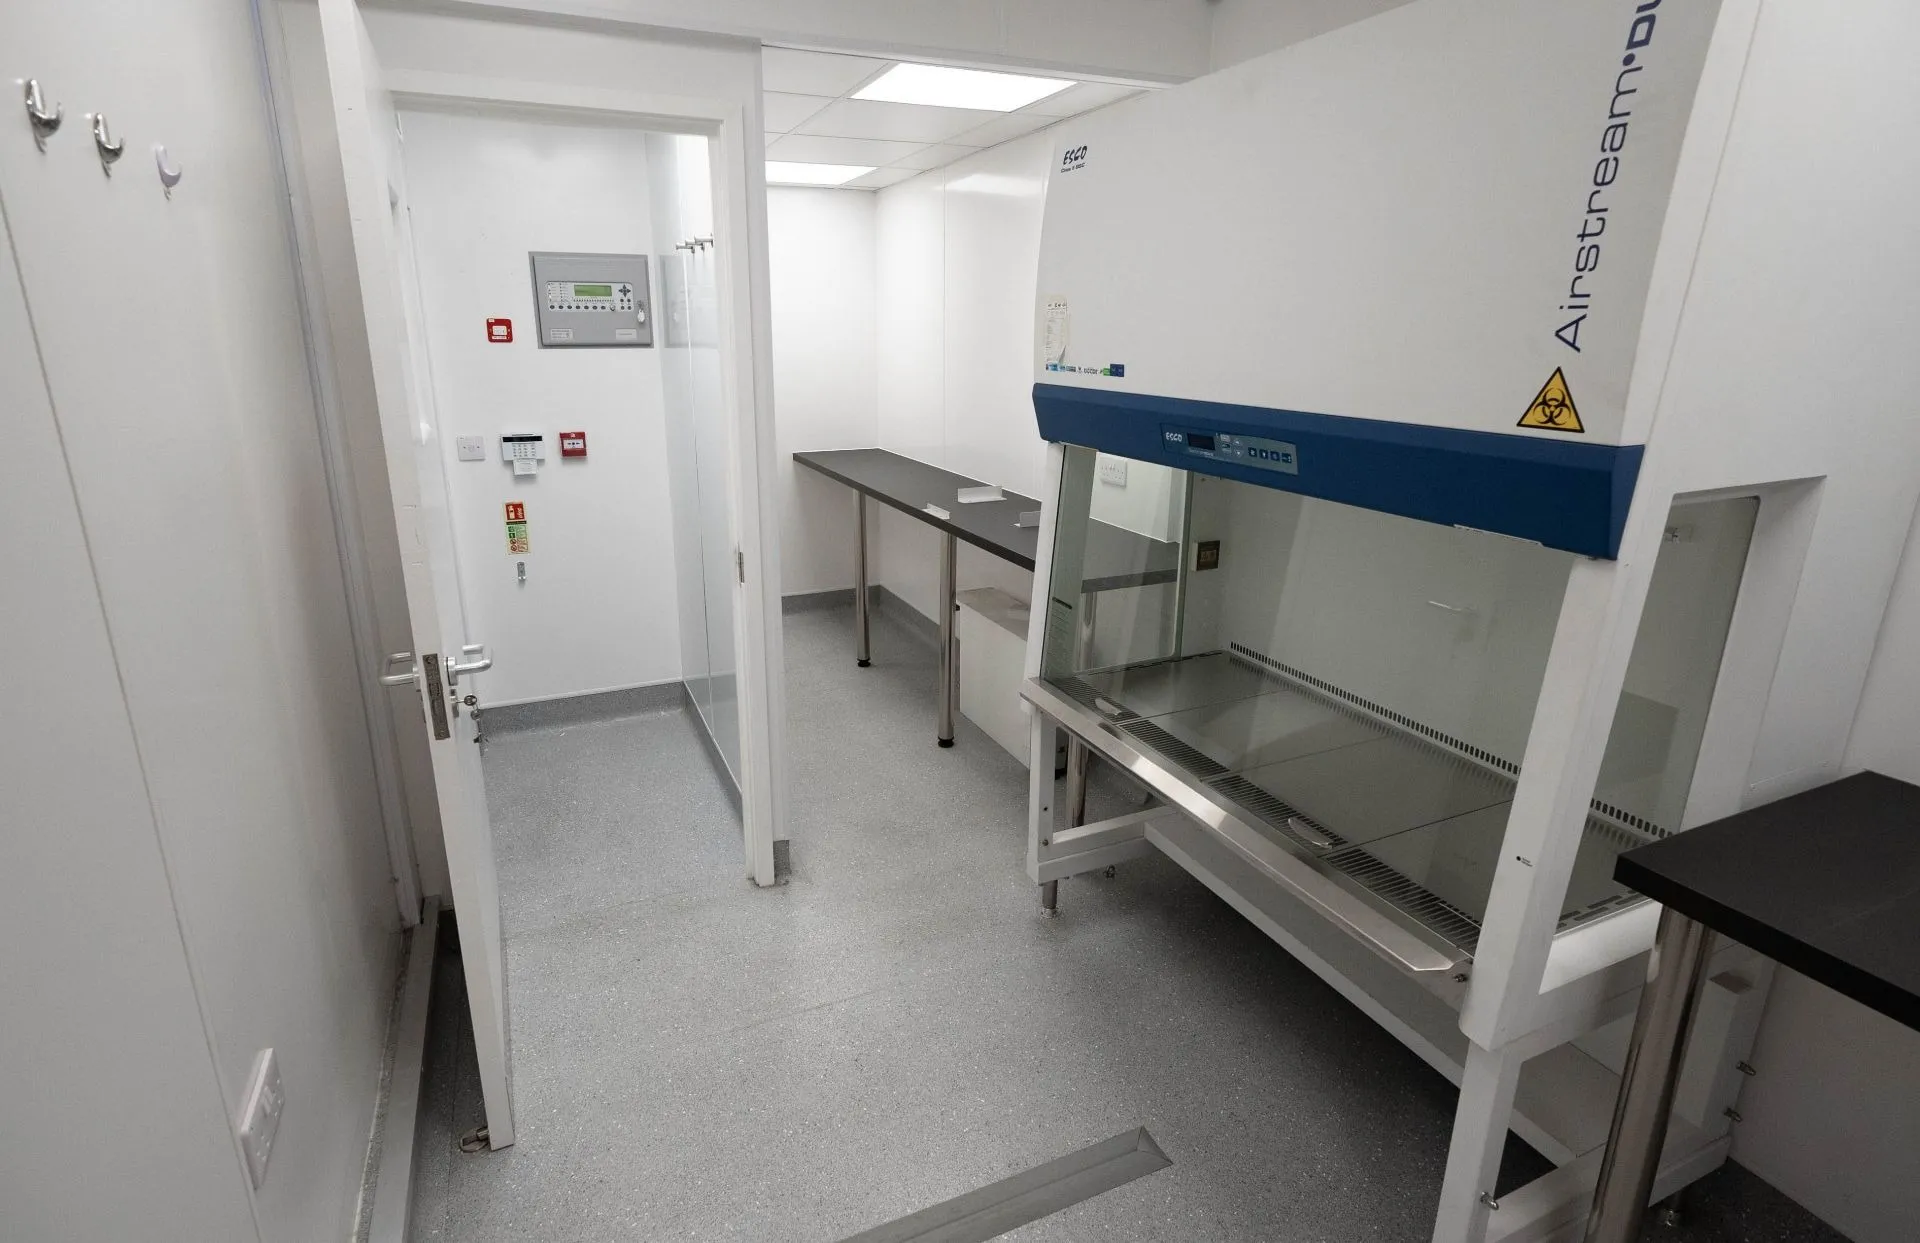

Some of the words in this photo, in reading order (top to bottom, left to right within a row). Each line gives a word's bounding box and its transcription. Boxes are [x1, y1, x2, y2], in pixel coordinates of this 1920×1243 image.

[1063, 145, 1087, 165] ESCO
[1554, 66, 1644, 353] Airstream
[1165, 432, 1183, 442] ESCO
